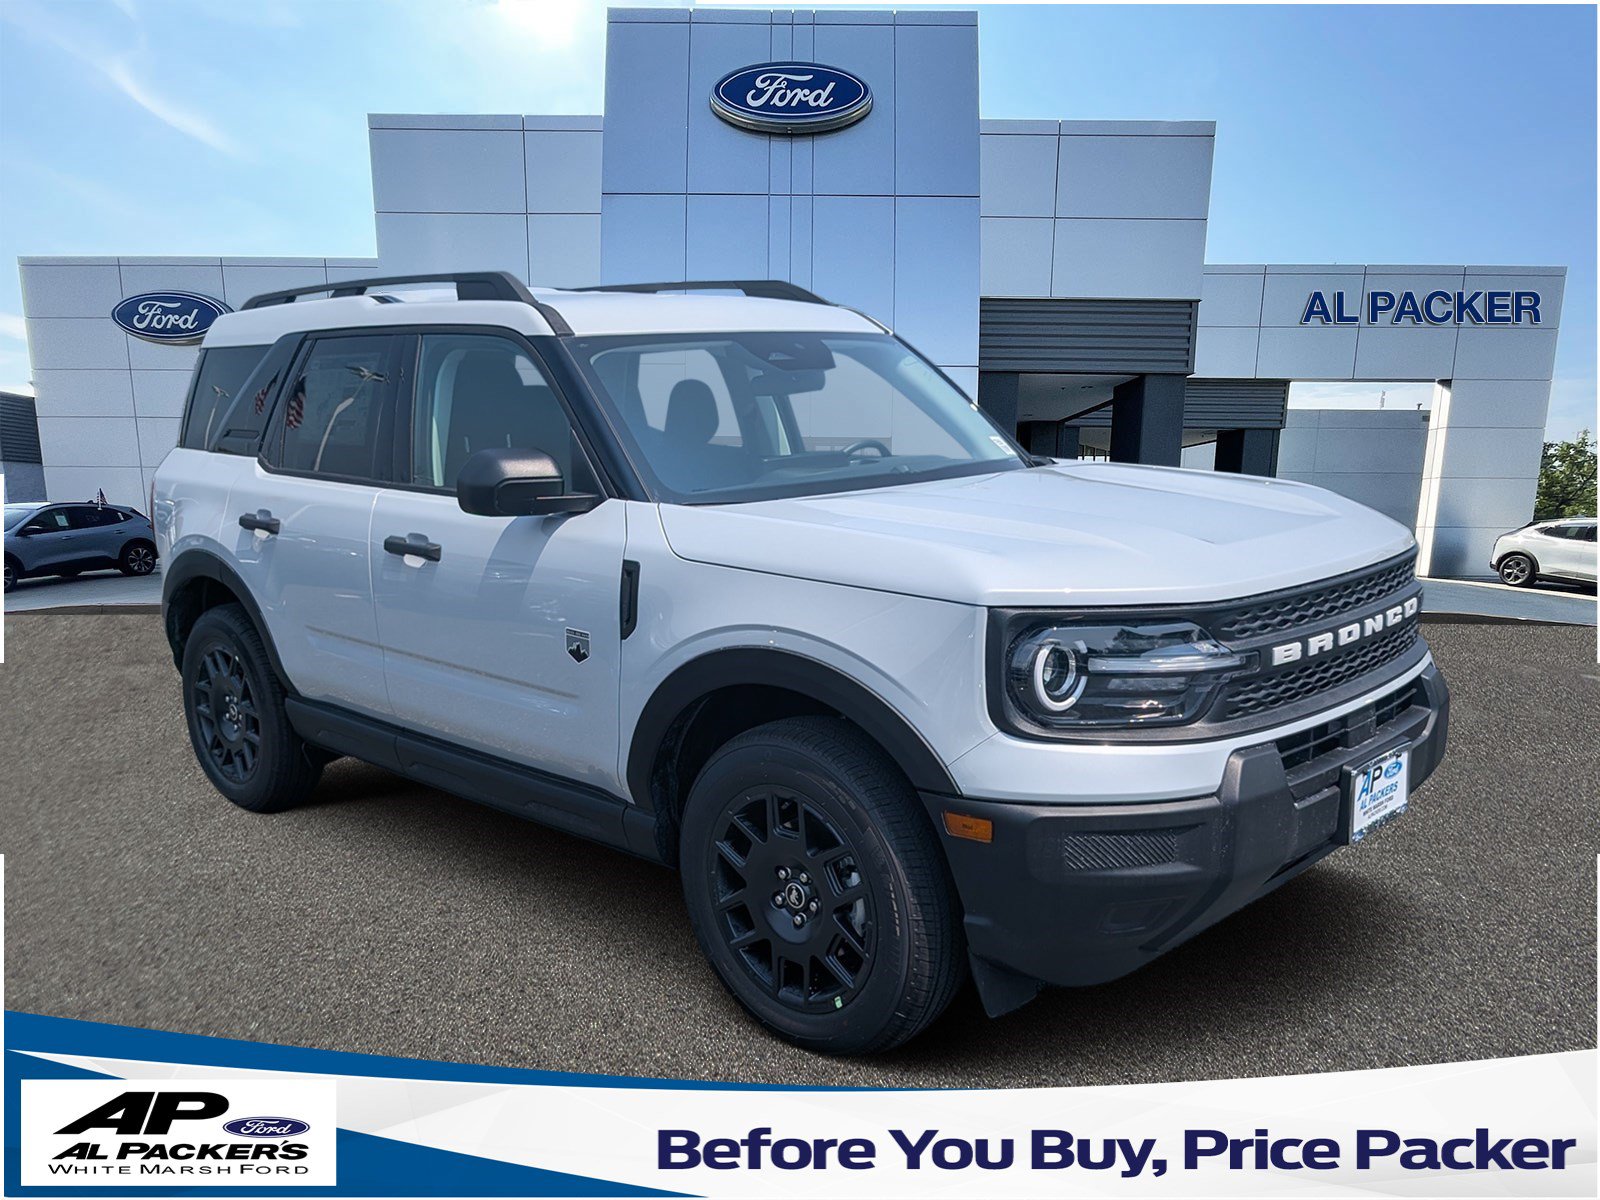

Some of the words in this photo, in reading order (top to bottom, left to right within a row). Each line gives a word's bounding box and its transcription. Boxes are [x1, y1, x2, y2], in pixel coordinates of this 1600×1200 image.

[746, 73, 836, 108] Ford
[133, 301, 199, 329] Ford
[1302, 290, 1360, 324] AL
[1368, 290, 1542, 324] PACKER
[1272, 597, 1418, 666] BRONCO
[1357, 765, 1383, 801] AP
